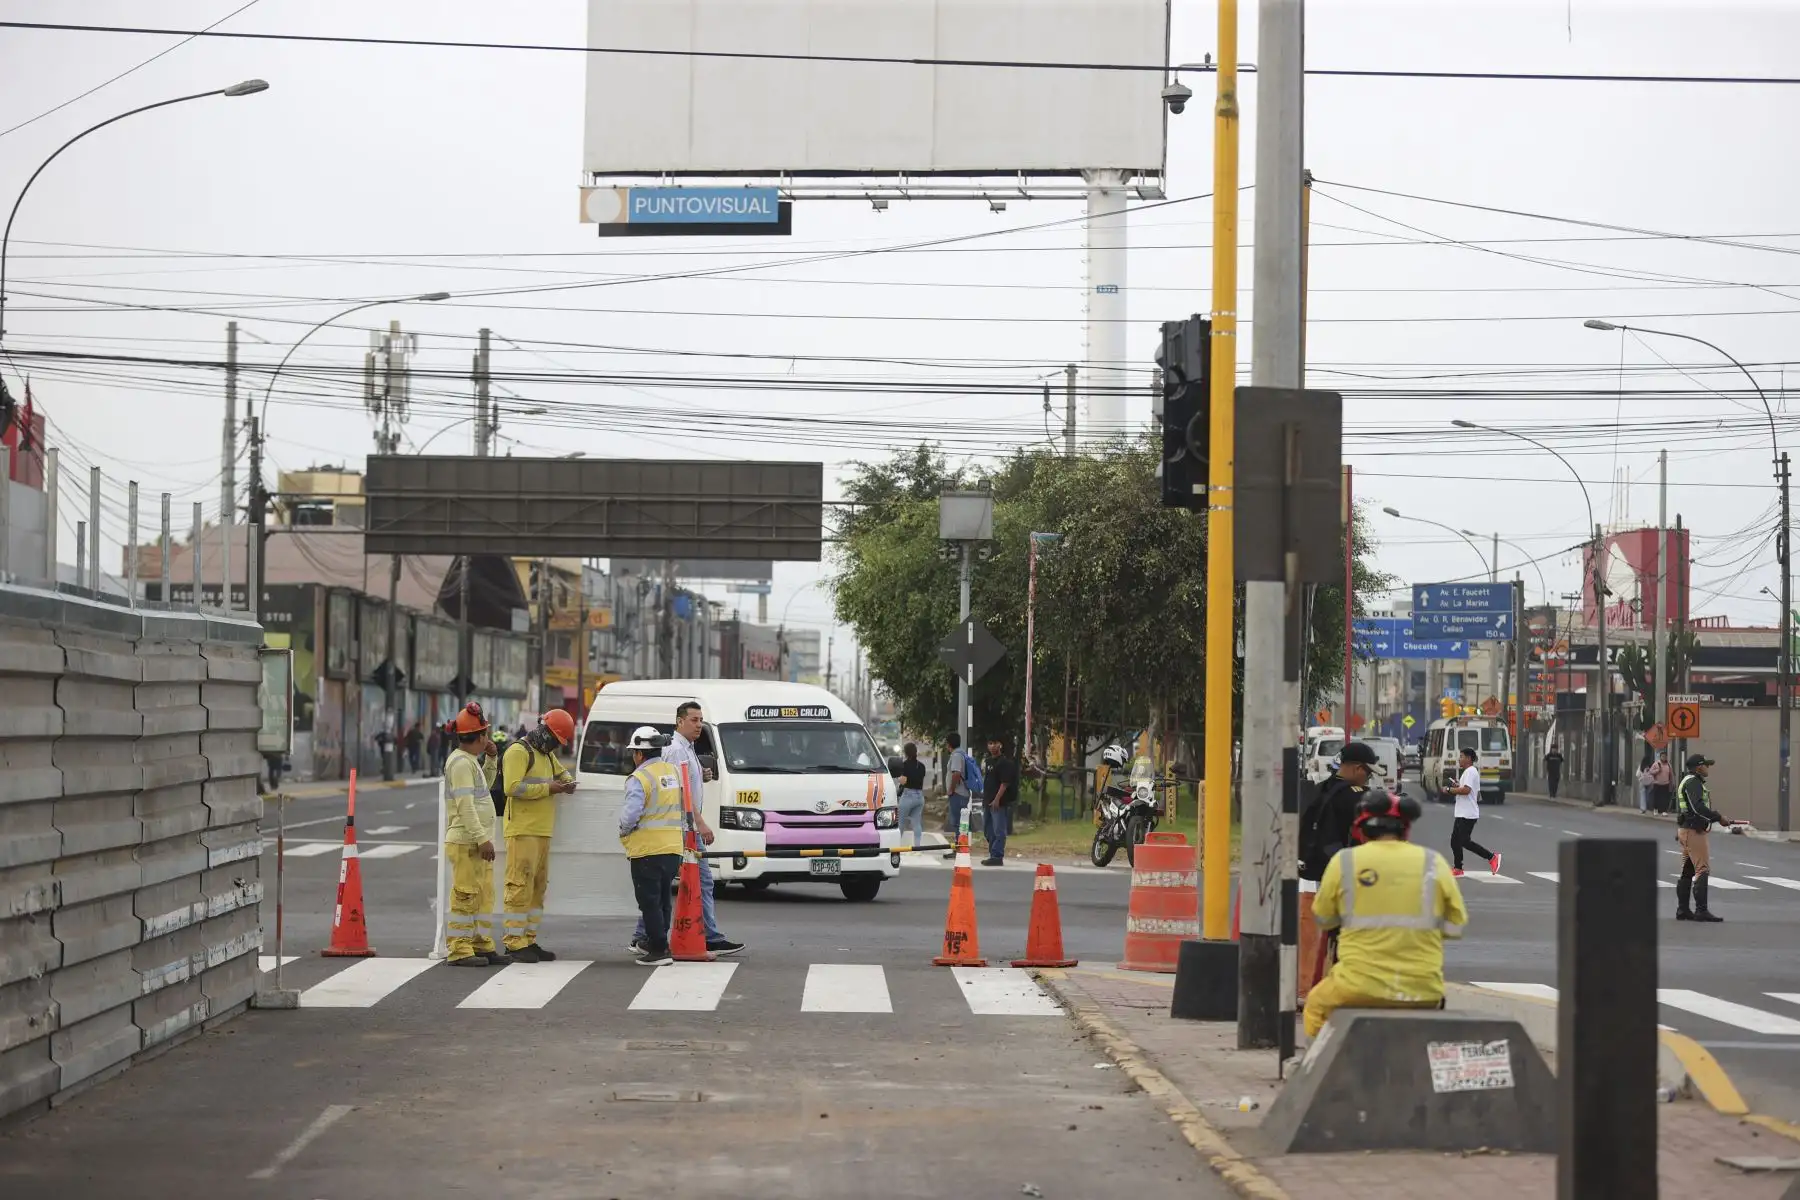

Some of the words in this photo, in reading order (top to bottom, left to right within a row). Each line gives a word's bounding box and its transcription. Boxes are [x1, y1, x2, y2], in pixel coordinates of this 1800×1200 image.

[635, 197, 771, 214] PUNTOVISUAL
[1462, 588, 1490, 596] Faucett
[1451, 615, 1488, 623] Benavides
[1485, 630, 1498, 638] 150
[750, 708, 779, 717] CALLAO
[800, 708, 829, 716] CALLAO
[738, 791, 759, 803] 1162
